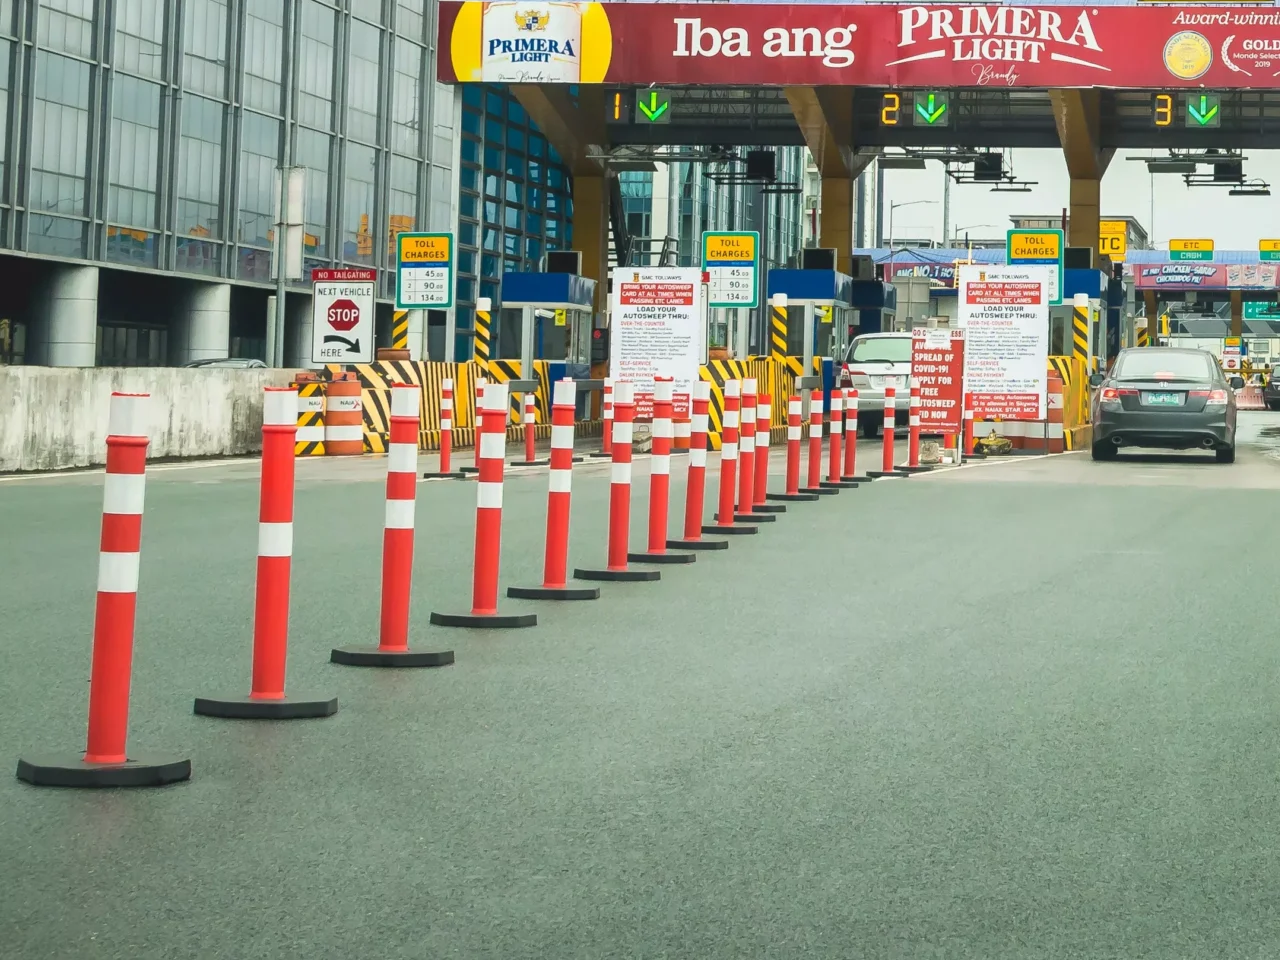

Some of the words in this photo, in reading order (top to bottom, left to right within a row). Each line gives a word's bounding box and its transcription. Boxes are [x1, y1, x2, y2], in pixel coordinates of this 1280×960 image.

[896, 6, 1103, 51] PRIMERA
[672, 17, 751, 58] Iba
[762, 23, 858, 68] ang
[488, 38, 576, 57] PRIMERA
[952, 38, 1046, 64] LIGHT
[511, 52, 551, 63] LIGHT
[971, 63, 1020, 86] Brandy
[614, 92, 621, 120] 1
[881, 93, 900, 125] 2
[1155, 94, 1173, 126] 3
[414, 240, 436, 248] TOLL
[720, 239, 741, 247] TOLL
[1024, 236, 1045, 245] TOLL
[1099, 237, 1120, 250] TC
[405, 250, 446, 259] CHARGES
[710, 250, 750, 258] CHARGES
[1014, 247, 1055, 256] CHARGES
[318, 271, 329, 279] NO
[333, 271, 371, 279] TAILGATING
[318, 287, 337, 296] NEXT
[339, 287, 372, 296] VEHICLE
[328, 308, 359, 322] STOP
[320, 348, 342, 358] HERE
[914, 353, 942, 362] SPREAD
[944, 353, 955, 362] OF
[913, 365, 949, 373] COVID-19!
[937, 376, 953, 385] FOR
[920, 387, 939, 396] FREE
[919, 399, 956, 408] UTOSWEEP
[931, 410, 948, 419] NOW
